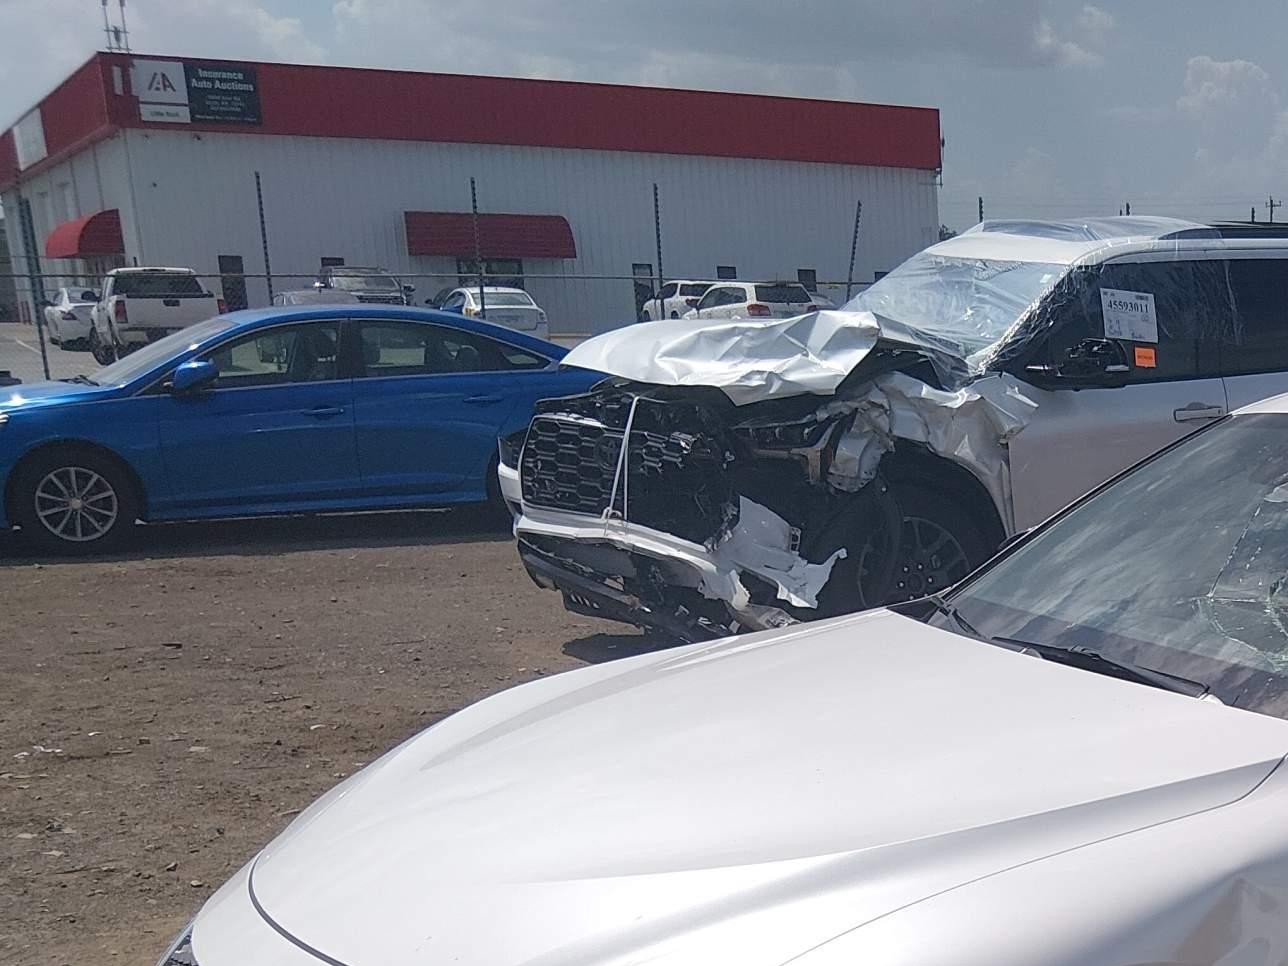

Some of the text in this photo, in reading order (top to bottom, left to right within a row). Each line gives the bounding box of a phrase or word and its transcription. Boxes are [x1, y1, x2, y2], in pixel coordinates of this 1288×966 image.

[198, 68, 244, 80] Insurance
[191, 78, 254, 92] Auto Auctions
[1107, 299, 1149, 314] 45593011
